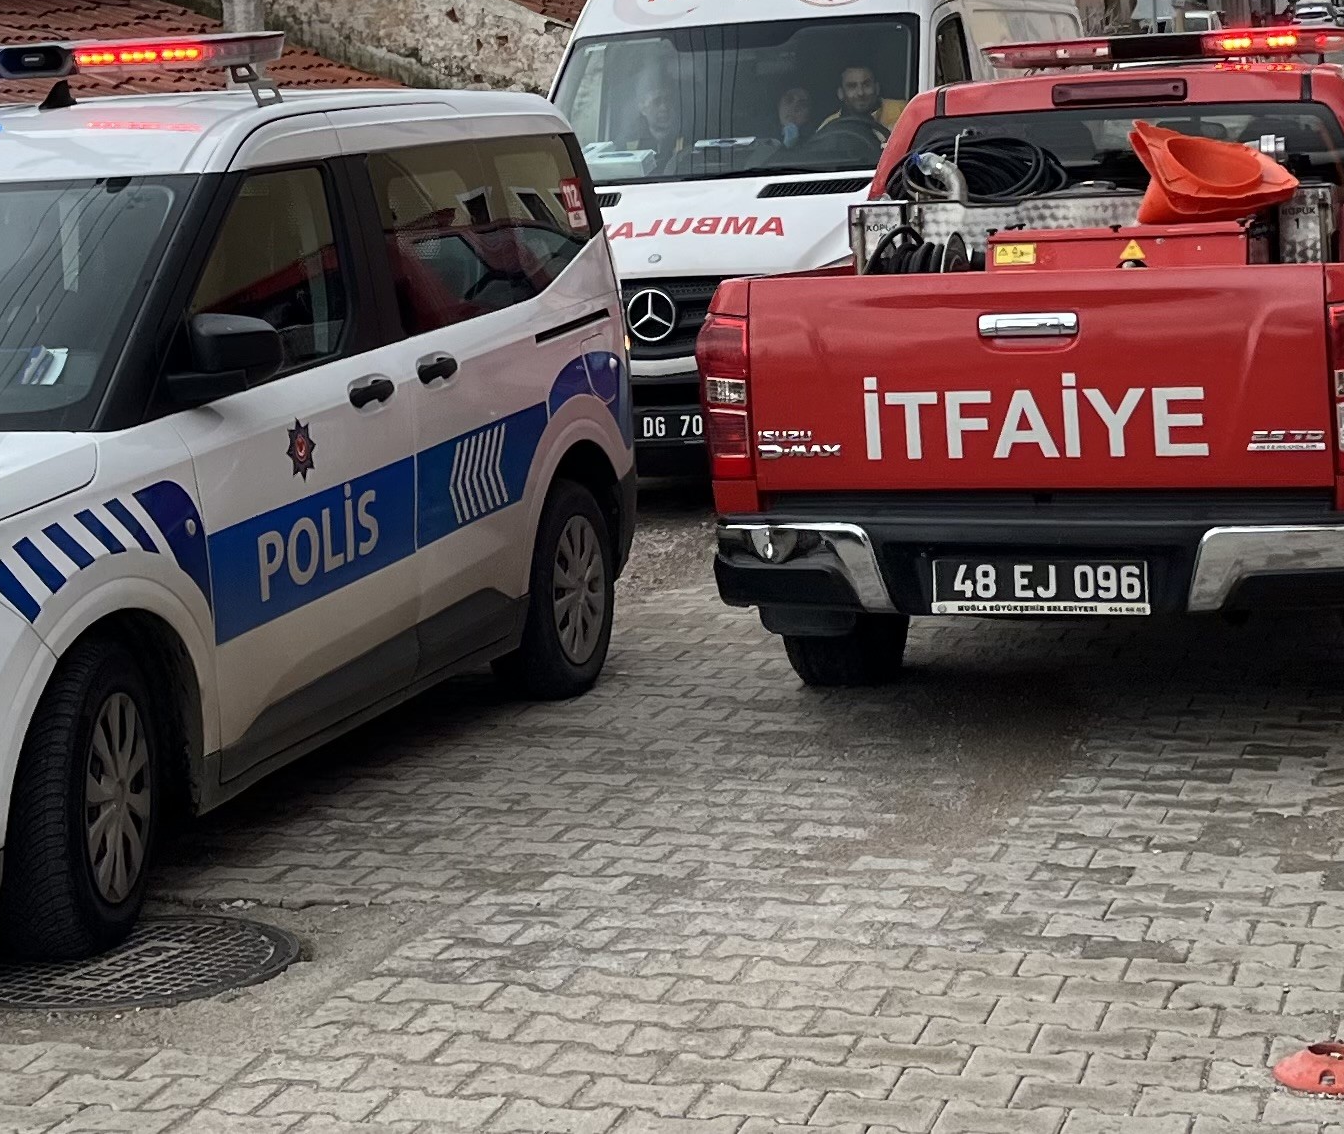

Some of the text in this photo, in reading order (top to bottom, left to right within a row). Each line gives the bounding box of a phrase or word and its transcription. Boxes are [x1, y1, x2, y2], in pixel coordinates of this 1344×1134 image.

[562, 184, 582, 209] 112
[1294, 217, 1300, 229] 1
[643, 416, 667, 438] DG
[863, 371, 1210, 461] İTFAİYE
[757, 430, 812, 443] ISUZU
[757, 444, 842, 460] D-MAX
[257, 482, 380, 603] POLİS
[954, 564, 1142, 600] 48 EJ 096
